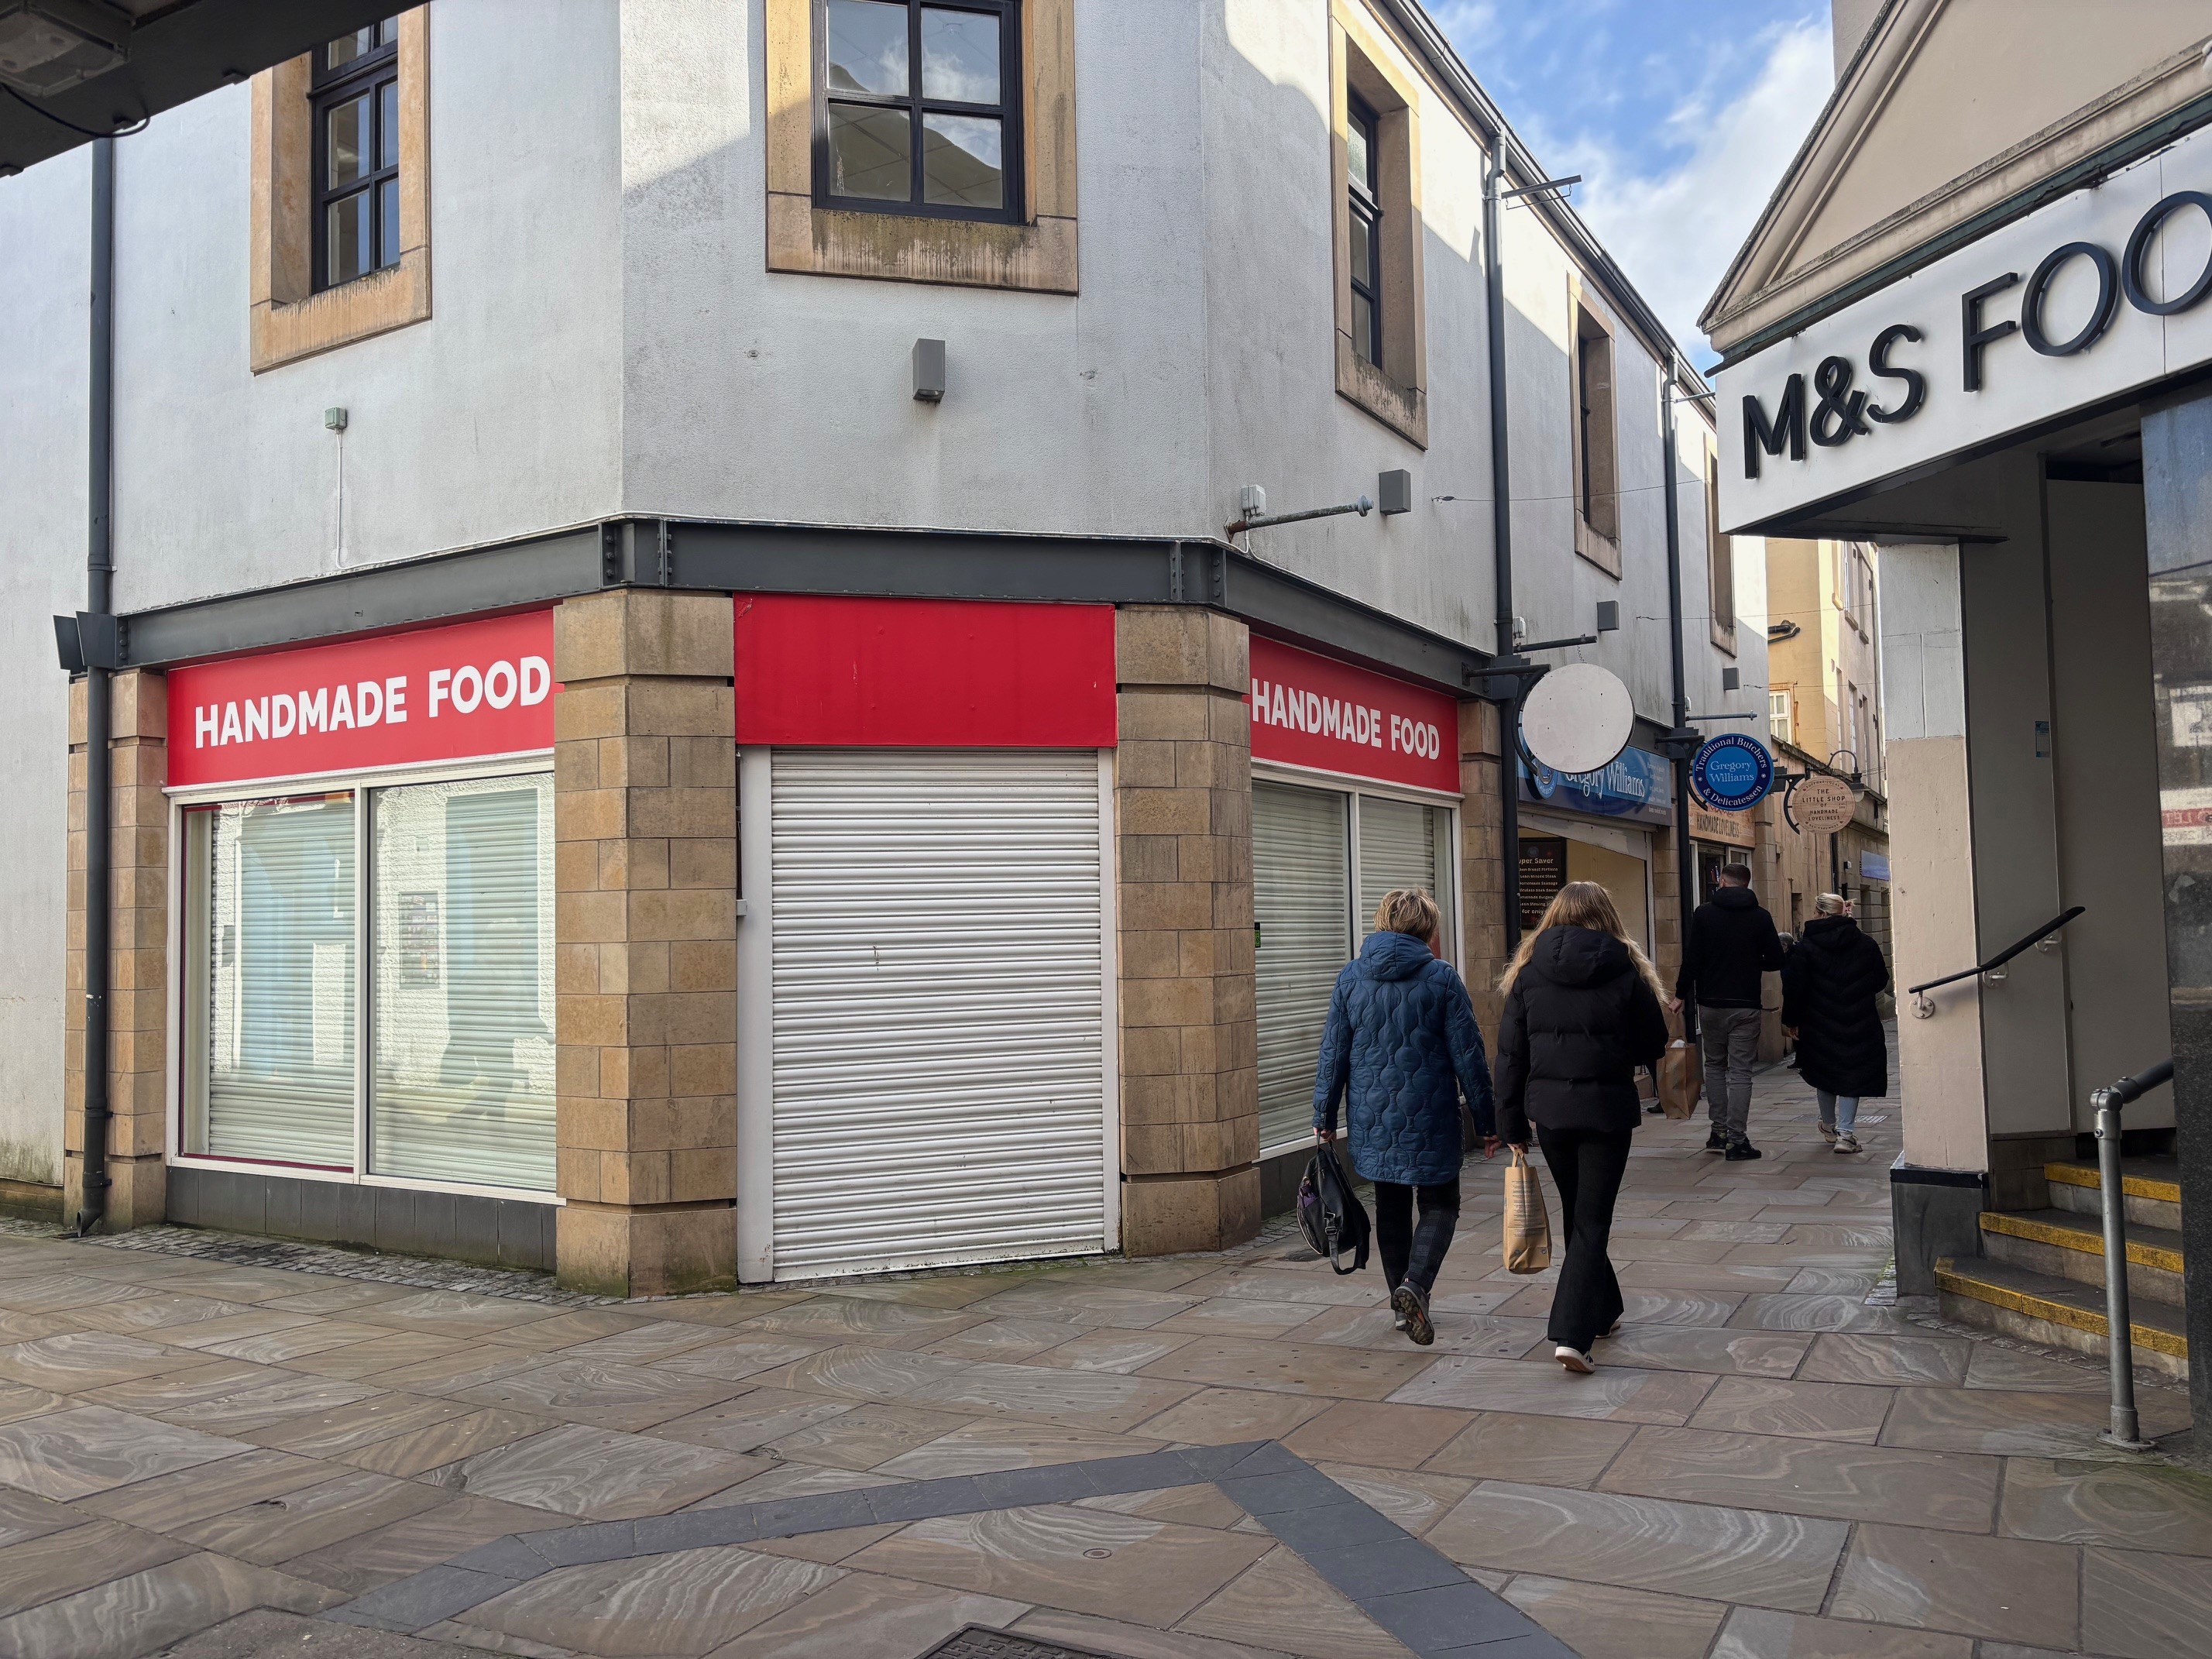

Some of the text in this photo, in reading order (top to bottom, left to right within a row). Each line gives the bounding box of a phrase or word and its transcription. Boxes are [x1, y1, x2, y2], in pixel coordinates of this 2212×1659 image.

[1743, 324, 1924, 479] M&S
[195, 655, 551, 749] HANDMADE FOOD
[1252, 678, 1440, 760] HANDMADE FOOD
[1695, 737, 1767, 771] Traditional Butchers
[1710, 761, 1752, 772] Gregory
[1606, 761, 1645, 798] Williams
[1709, 772, 1754, 783] Williams
[1703, 785, 1763, 806] & Delicatessen
